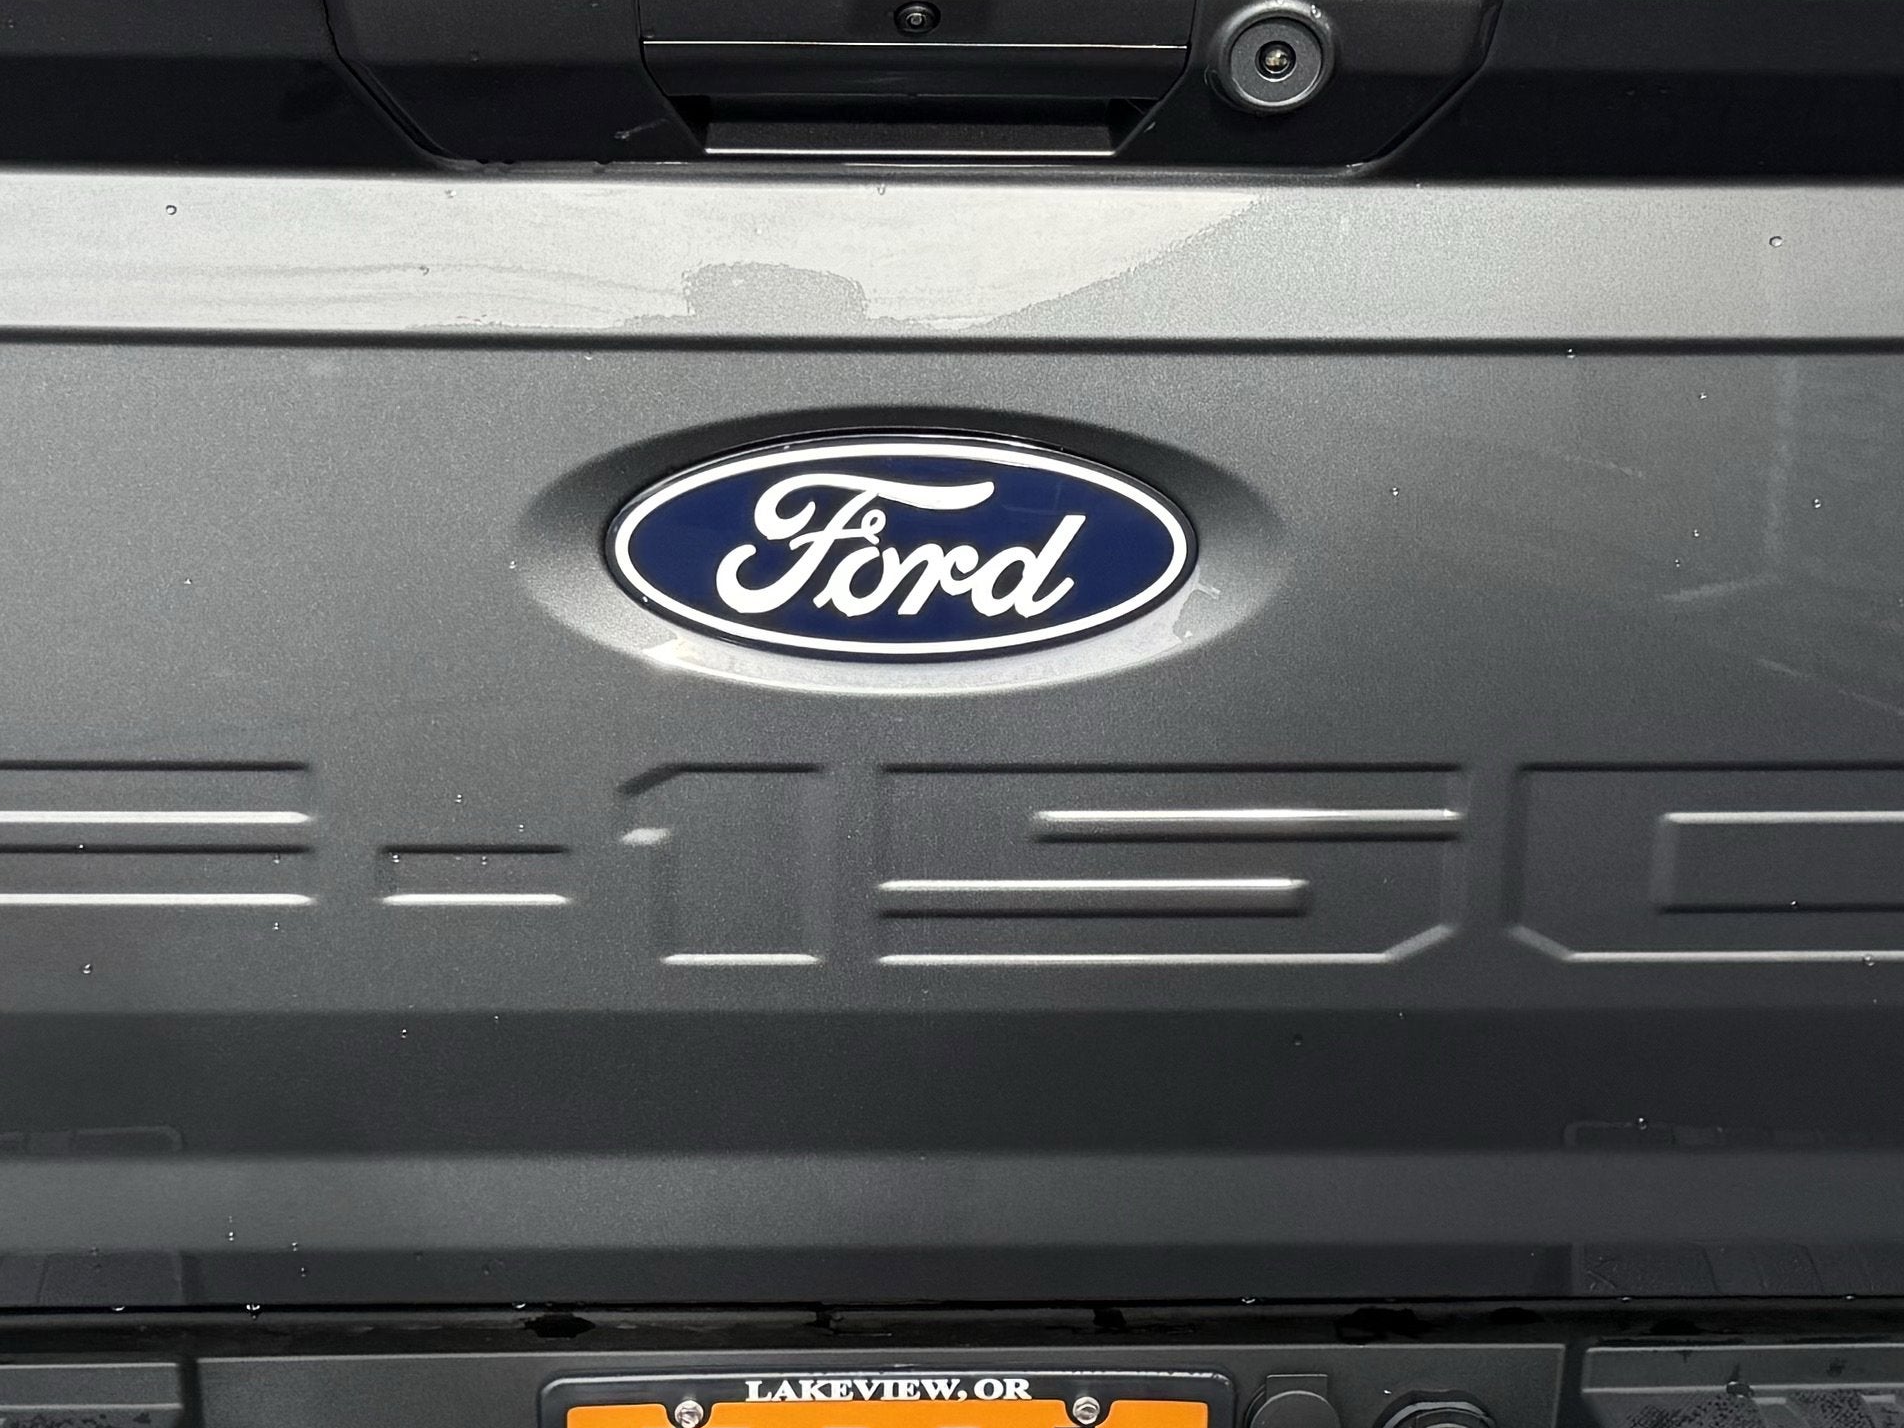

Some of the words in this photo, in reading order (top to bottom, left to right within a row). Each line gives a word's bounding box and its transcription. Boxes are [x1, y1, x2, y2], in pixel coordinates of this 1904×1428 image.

[716, 472, 1087, 619] Ford
[745, 1379, 968, 1403] LAKEVIEW,
[974, 1377, 1032, 1402] OR
